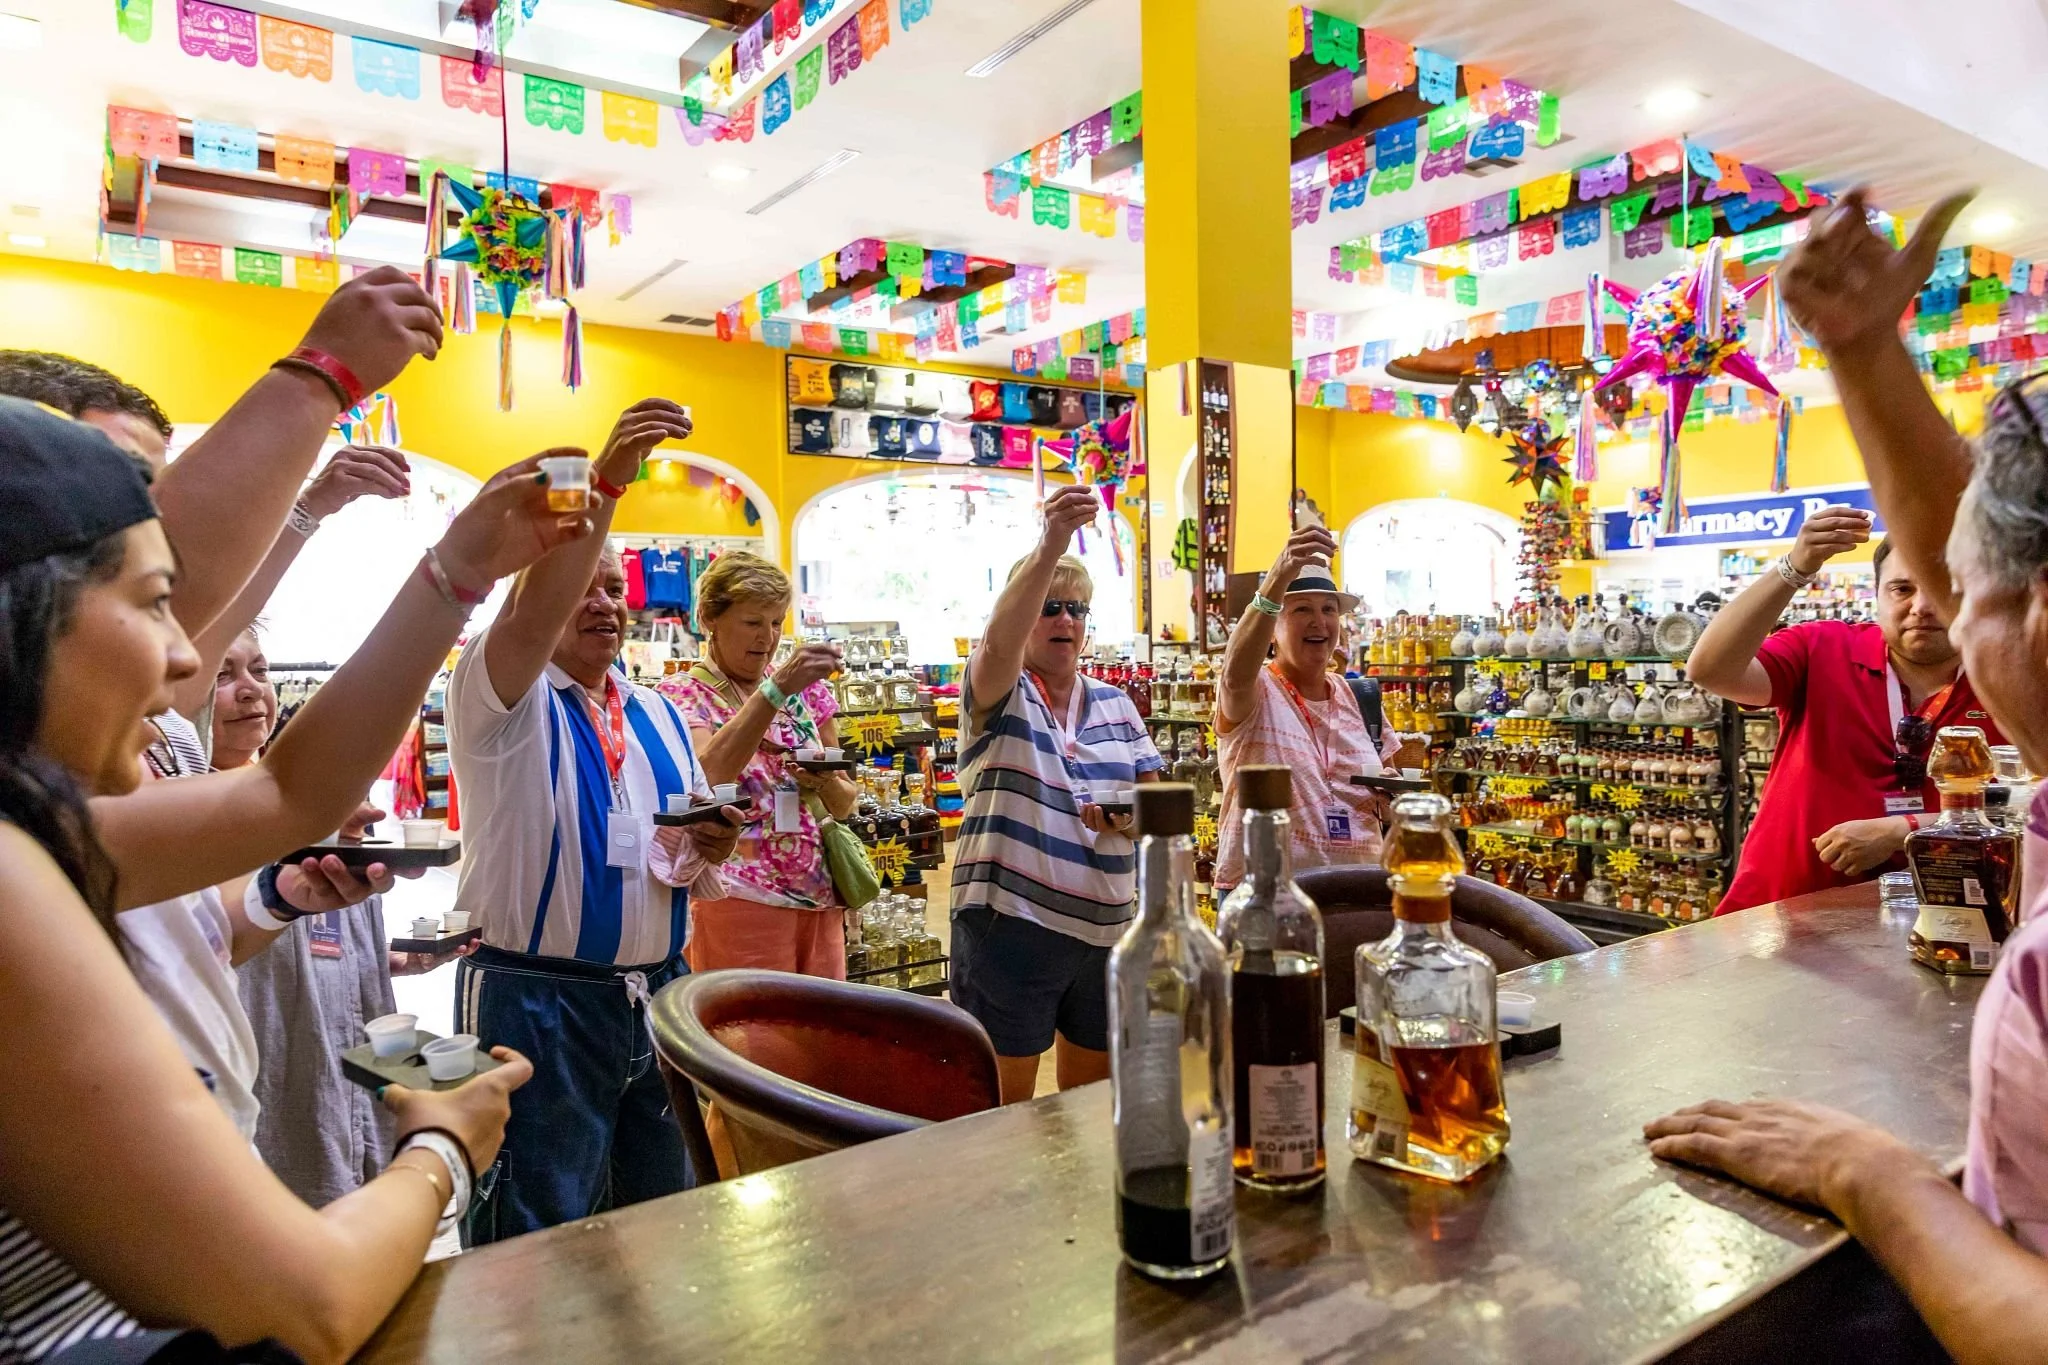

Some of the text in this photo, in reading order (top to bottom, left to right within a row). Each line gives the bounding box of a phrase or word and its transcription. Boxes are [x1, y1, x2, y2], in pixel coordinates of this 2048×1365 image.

[861, 727, 884, 743] 106
[1197, 825, 1208, 837] 59
[1484, 839, 1497, 848] 42
[873, 855, 896, 870] 105
